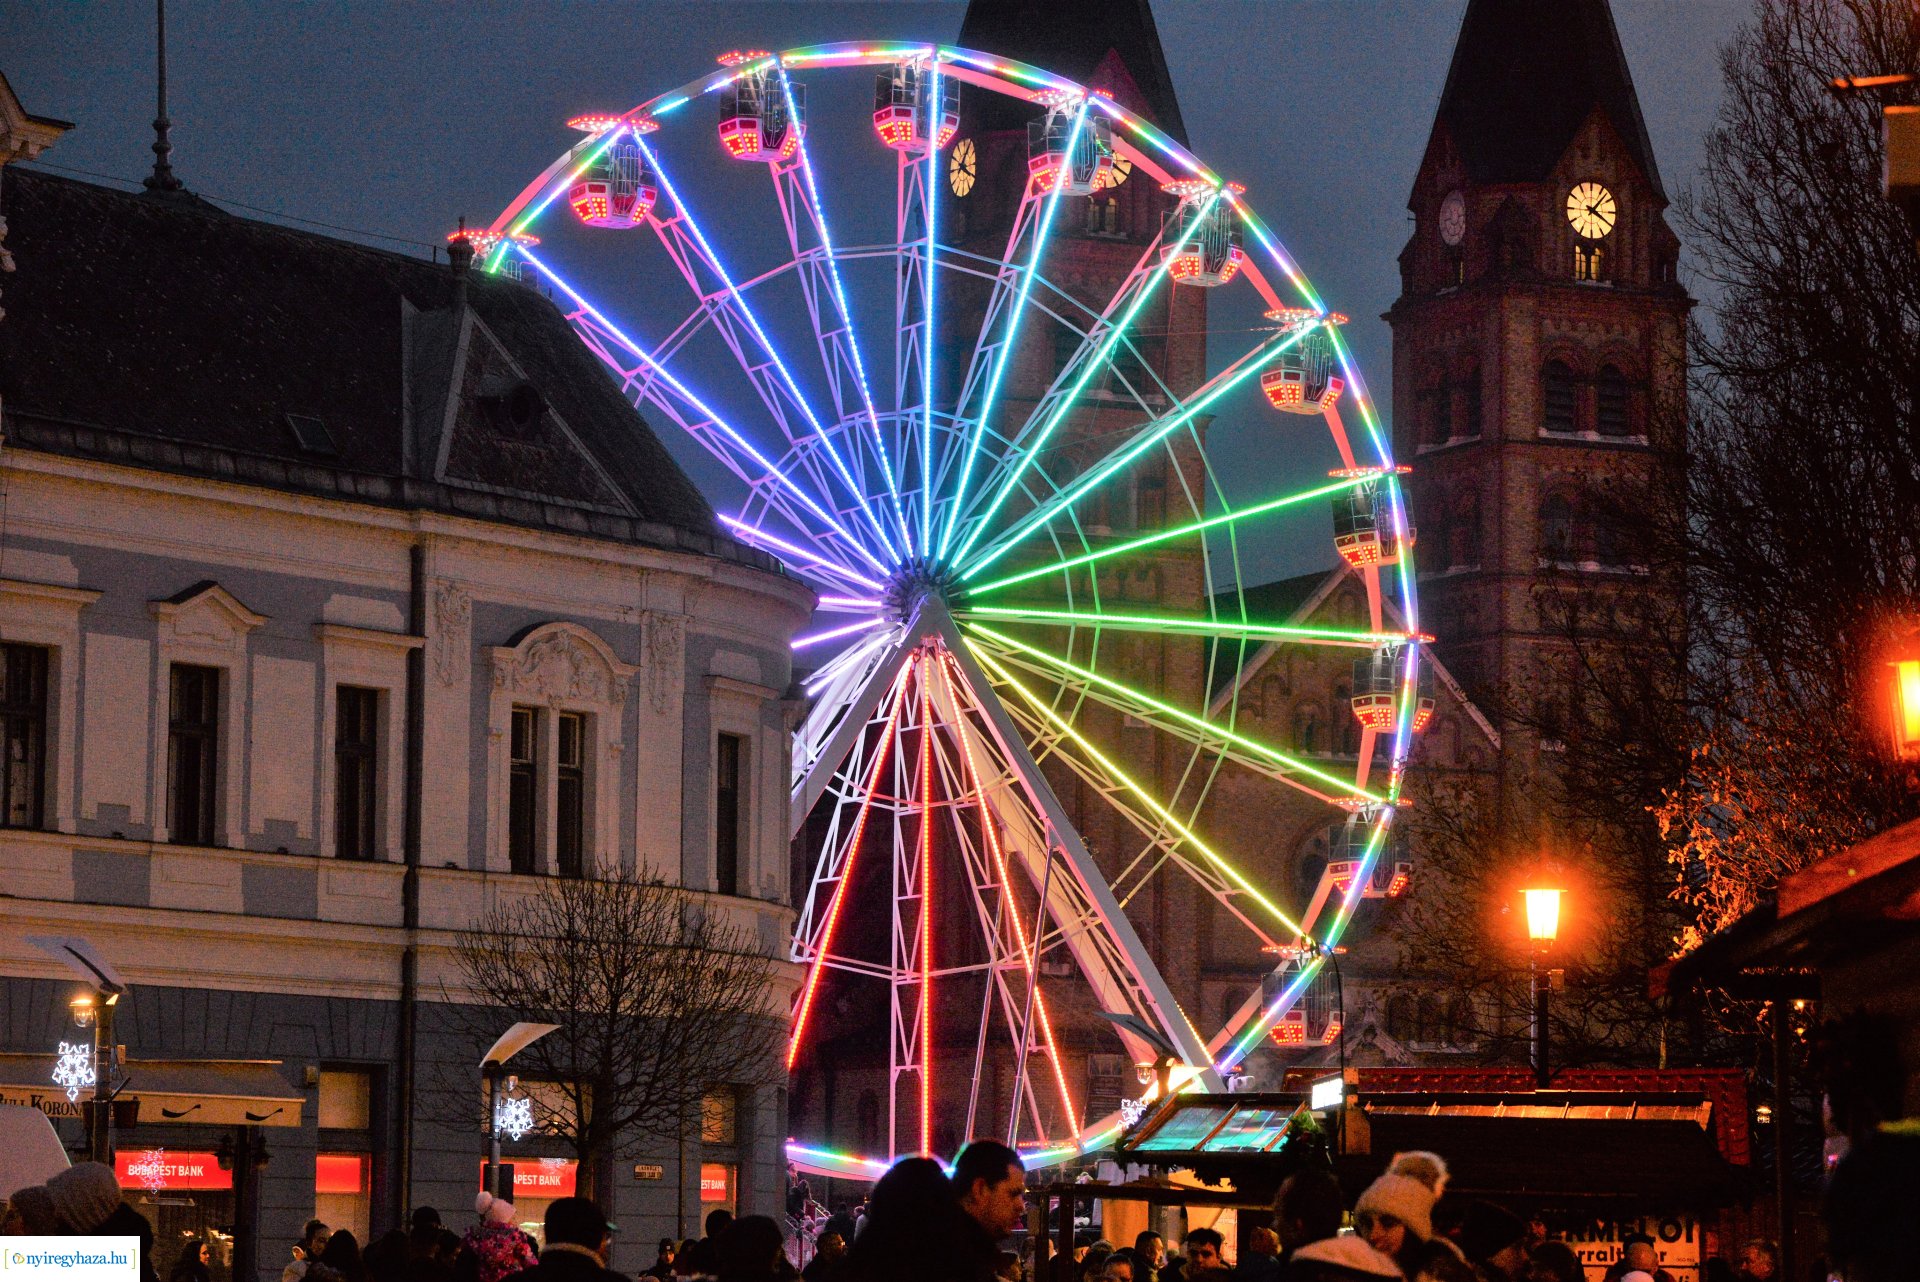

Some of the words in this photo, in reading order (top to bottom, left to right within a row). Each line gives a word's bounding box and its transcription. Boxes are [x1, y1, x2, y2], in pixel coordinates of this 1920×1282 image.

[30, 1094, 82, 1116] KORON
[128, 1164, 176, 1177] BUDAPEST
[178, 1165, 204, 1177] BANK
[513, 1174, 538, 1185] APEST
[539, 1175, 561, 1186] BANK
